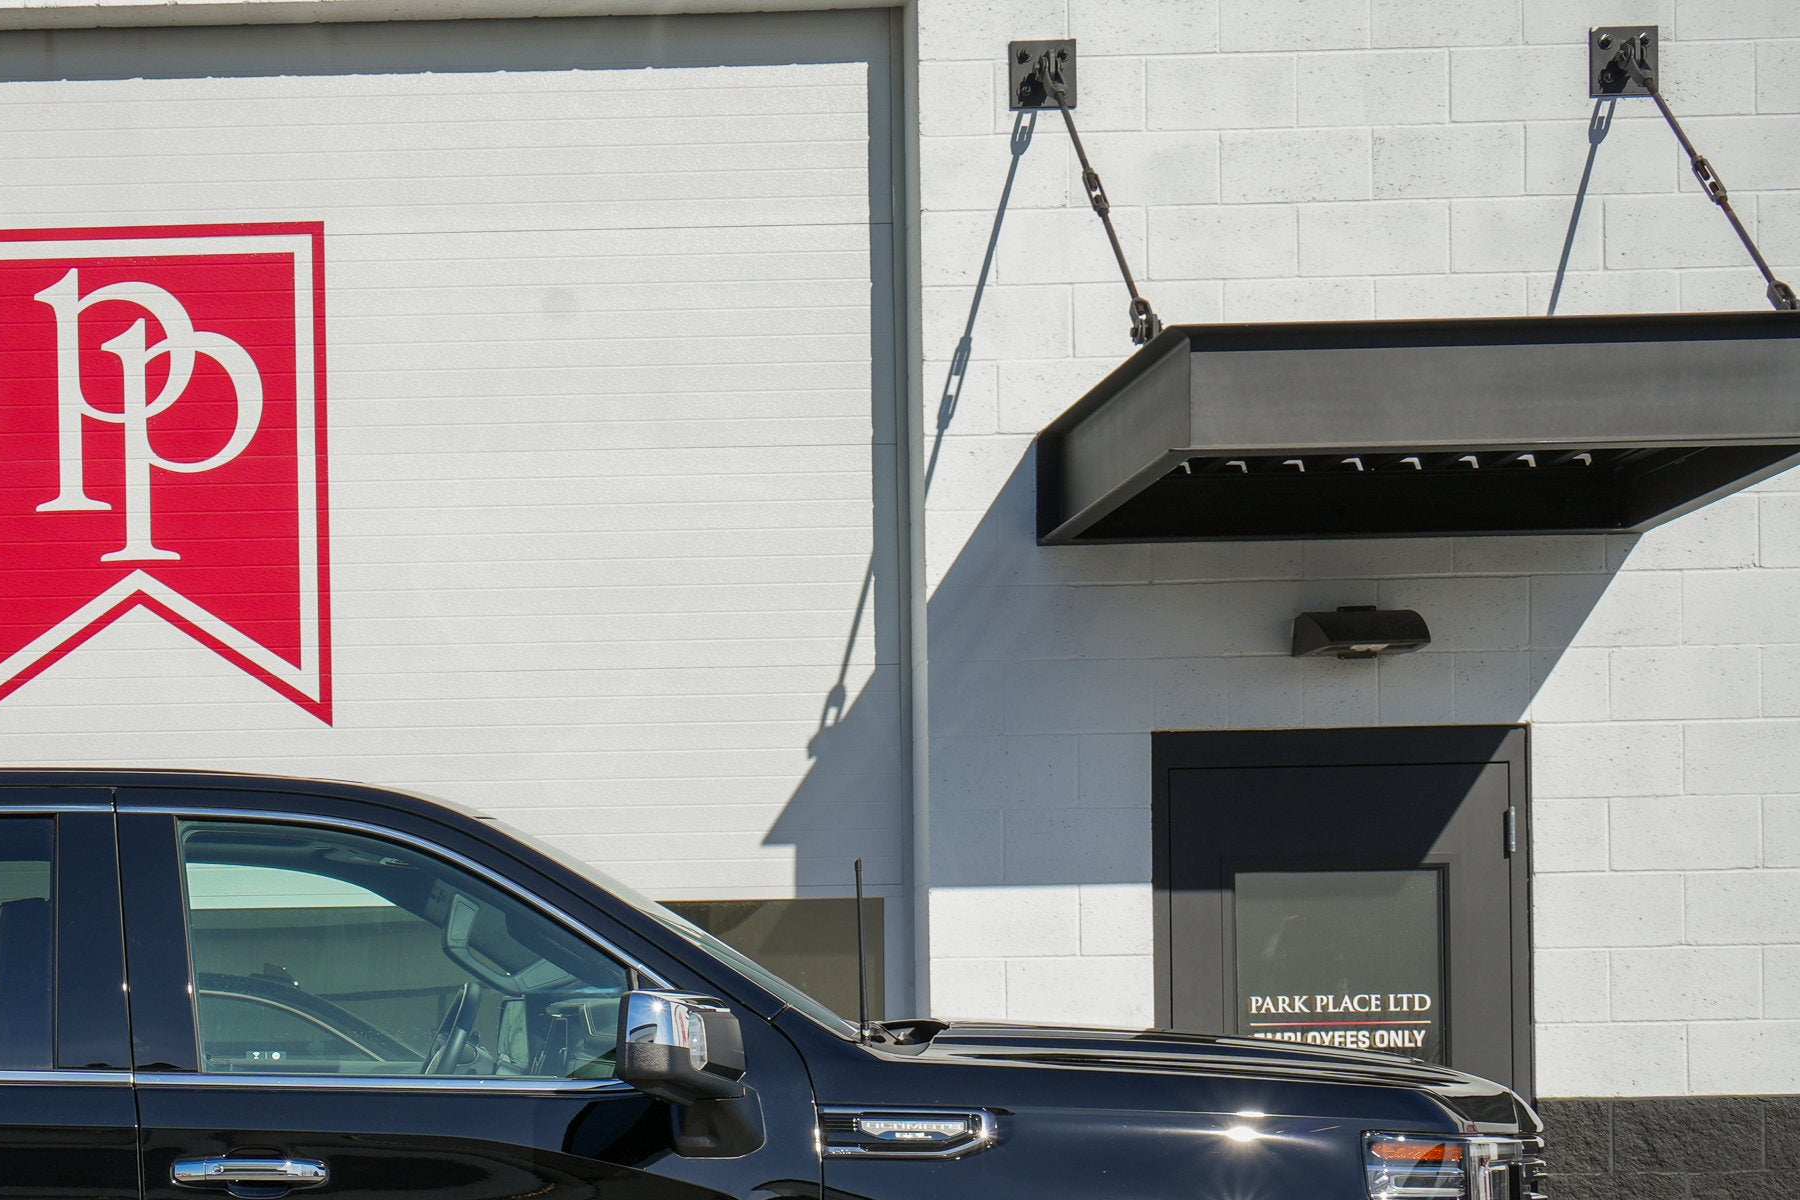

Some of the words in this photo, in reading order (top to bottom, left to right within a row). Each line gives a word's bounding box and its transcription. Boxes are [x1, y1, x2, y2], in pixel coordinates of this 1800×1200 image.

[1249, 995, 1311, 1014] PARK
[1315, 993, 1382, 1013] PLACE
[1388, 993, 1432, 1012] LTD
[1253, 1030, 1371, 1049] POYEES
[1375, 1030, 1426, 1048] ONLY
